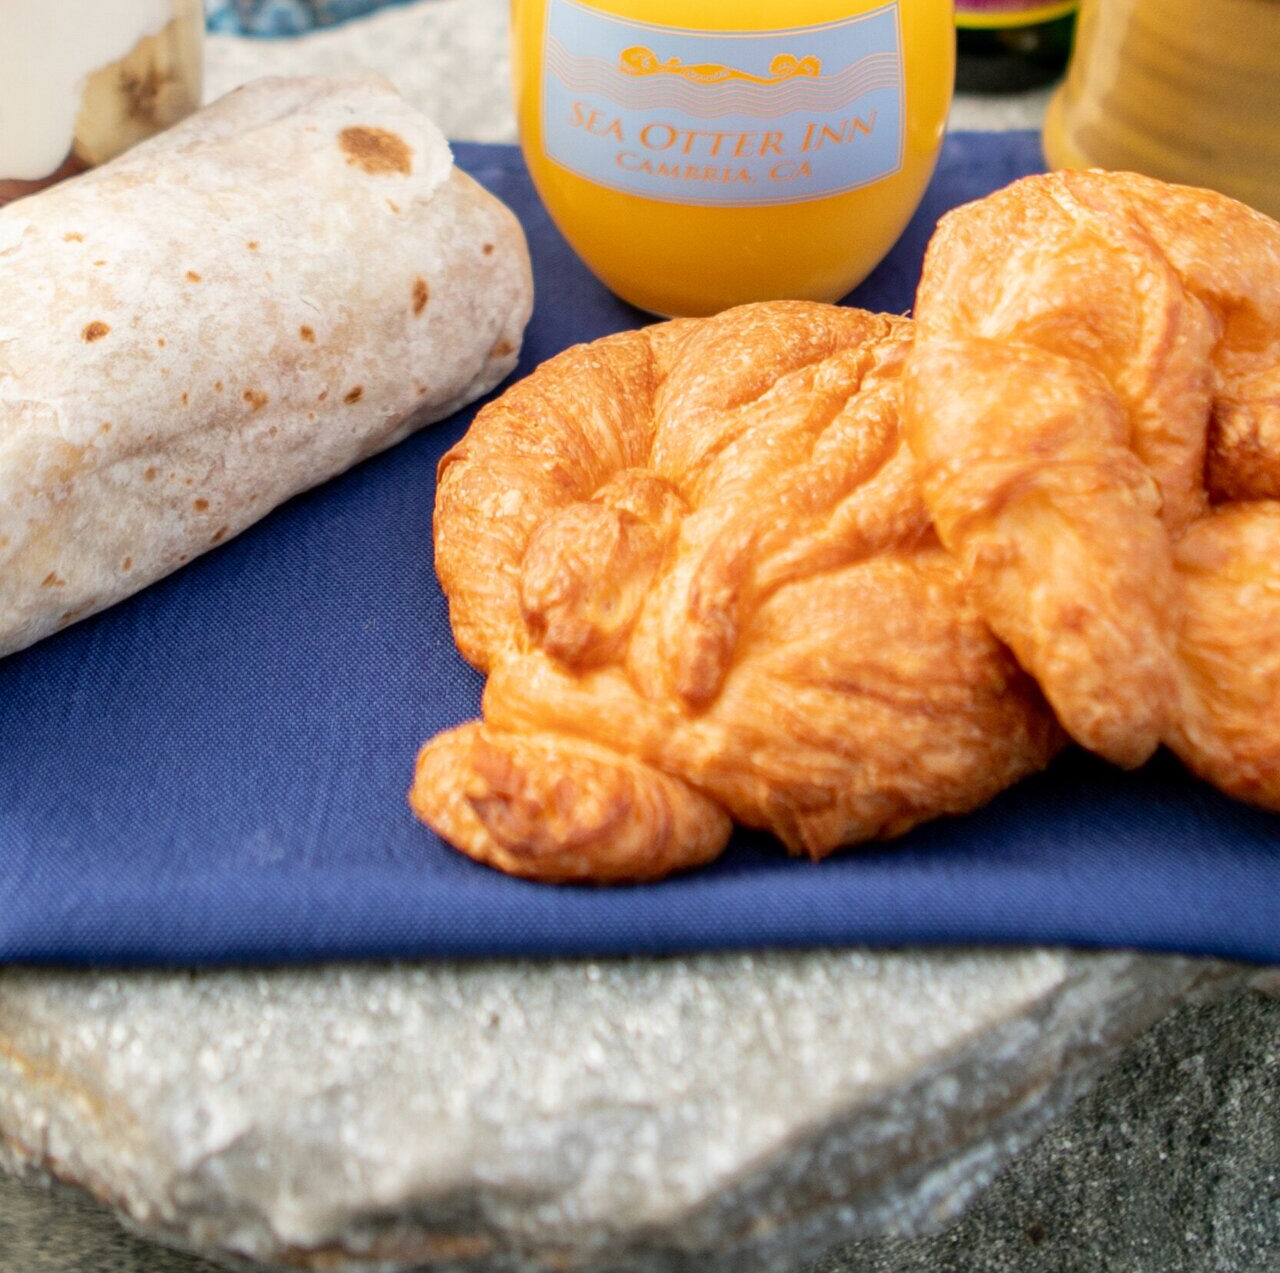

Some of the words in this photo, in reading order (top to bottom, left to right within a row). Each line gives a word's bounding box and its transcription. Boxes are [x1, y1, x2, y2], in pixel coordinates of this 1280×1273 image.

[568, 100, 625, 143] SEA
[639, 122, 786, 158] OTTER
[800, 108, 878, 153] INN
[768, 159, 814, 183] CA
